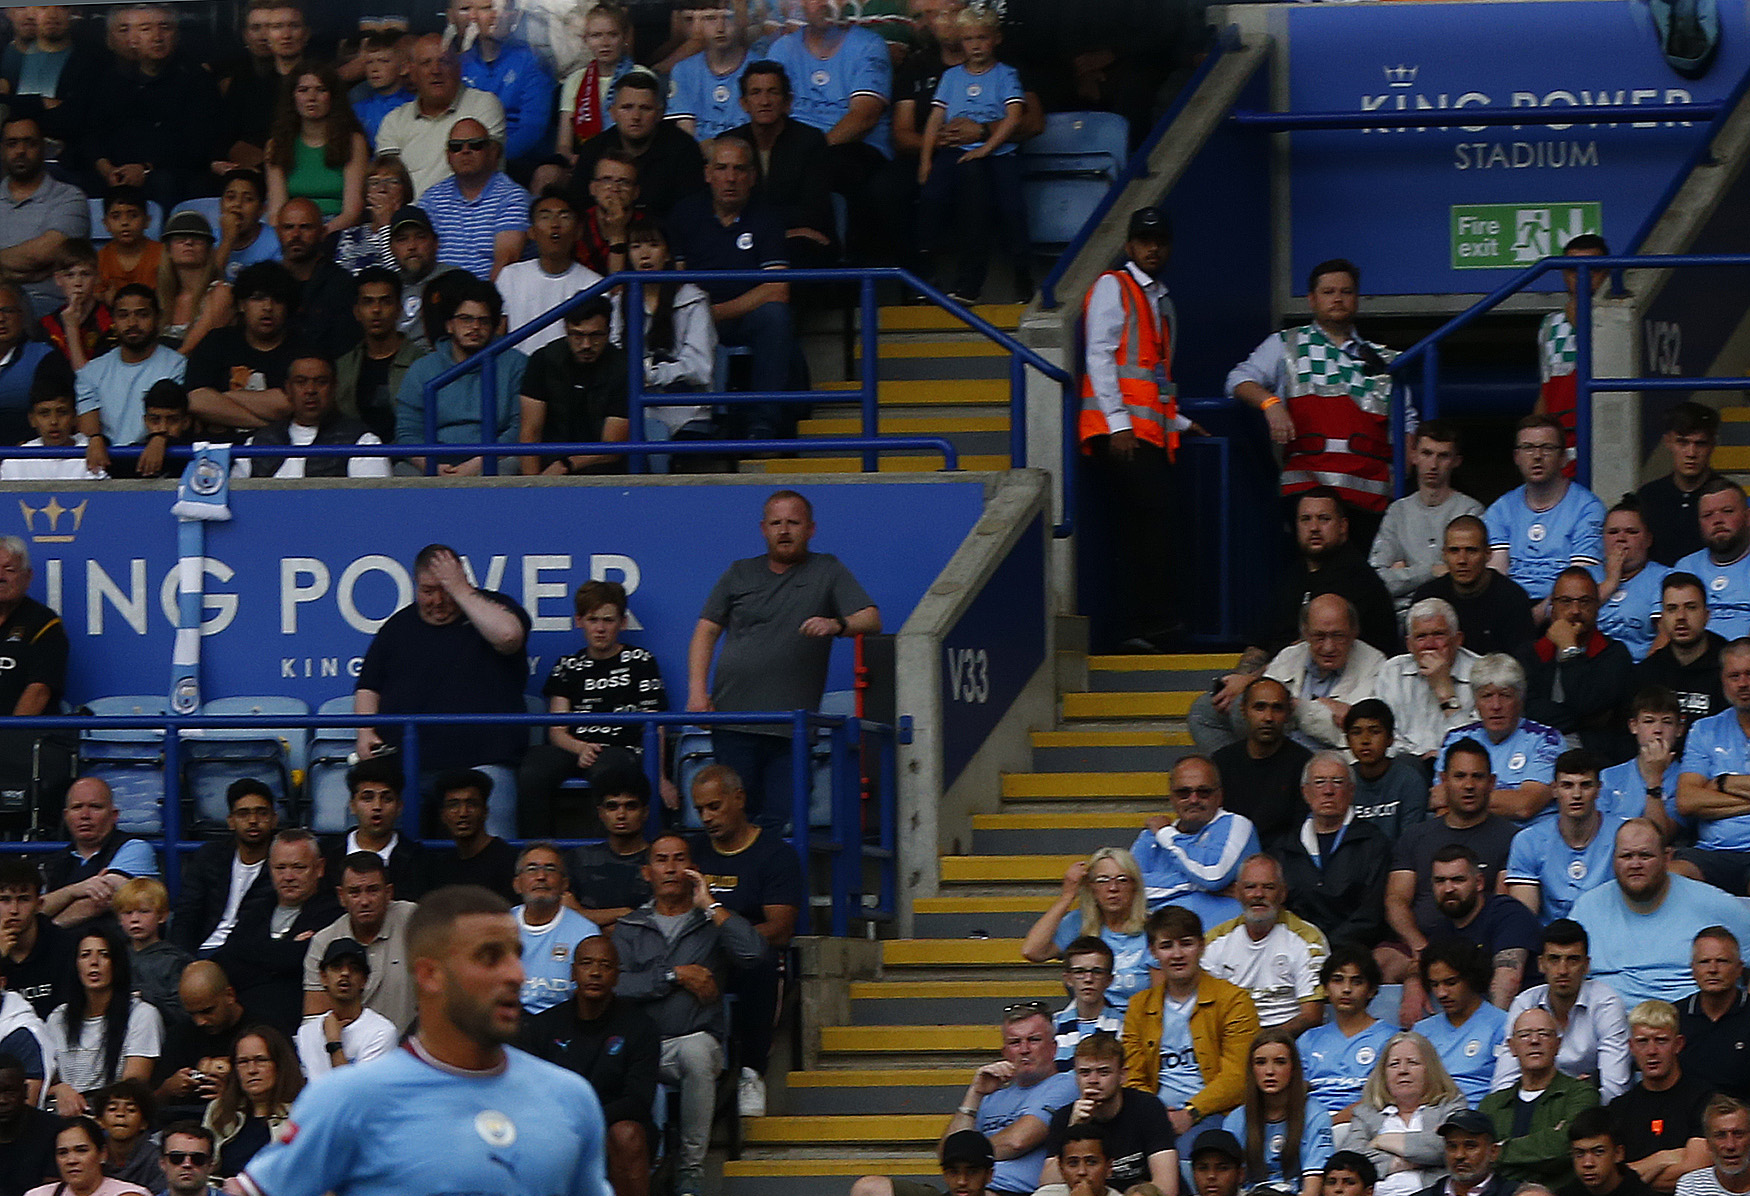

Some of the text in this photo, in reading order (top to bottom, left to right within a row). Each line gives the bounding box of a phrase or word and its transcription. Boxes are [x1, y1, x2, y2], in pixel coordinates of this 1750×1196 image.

[1512, 88, 1693, 129] POWER
[1455, 142, 1599, 170] STADIUM
[1458, 216, 1500, 236] Fire
[1458, 239, 1500, 257] exit
[1646, 320, 1681, 375] V32
[45, 556, 240, 637] ING
[584, 673, 631, 691] BOSS
[948, 648, 988, 703] V33
